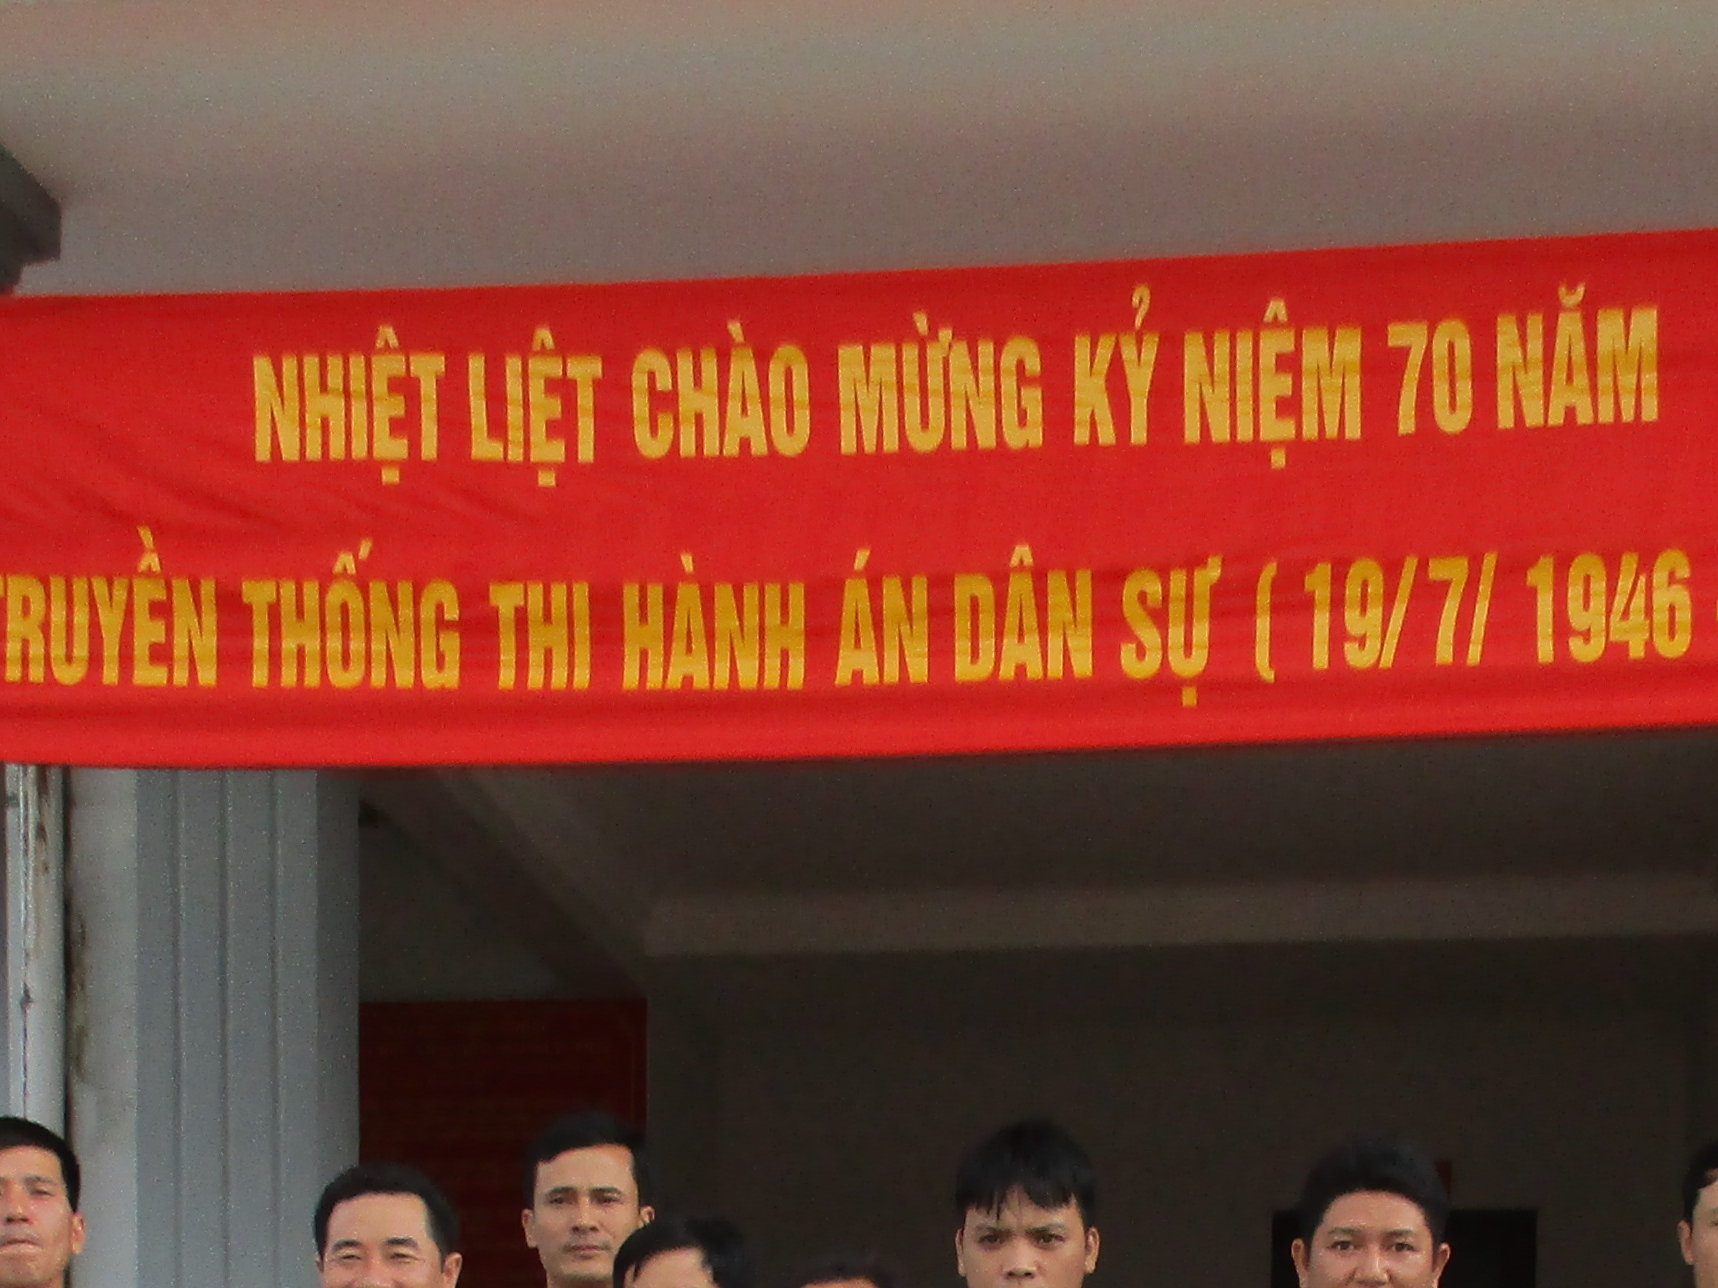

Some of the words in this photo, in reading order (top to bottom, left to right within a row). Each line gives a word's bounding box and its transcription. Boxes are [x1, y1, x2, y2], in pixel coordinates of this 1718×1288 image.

[252, 323, 447, 486] NHIỆT
[467, 325, 604, 488] LIỆT
[630, 319, 812, 460] CHÀO
[836, 310, 1045, 456] MỪNG
[1072, 283, 1160, 447] KỶ
[1182, 297, 1363, 470] NIỆM
[1386, 317, 1474, 436] 70
[1495, 282, 1660, 431] NĂM
[240, 537, 462, 691] THỐNG
[488, 579, 592, 691] THI
[621, 551, 806, 691] HÀNH
[833, 547, 930, 687] ÁN
[953, 542, 1094, 684] DÂN
[1118, 553, 1223, 707] SỰ
[1525, 547, 1693, 665] 1946
